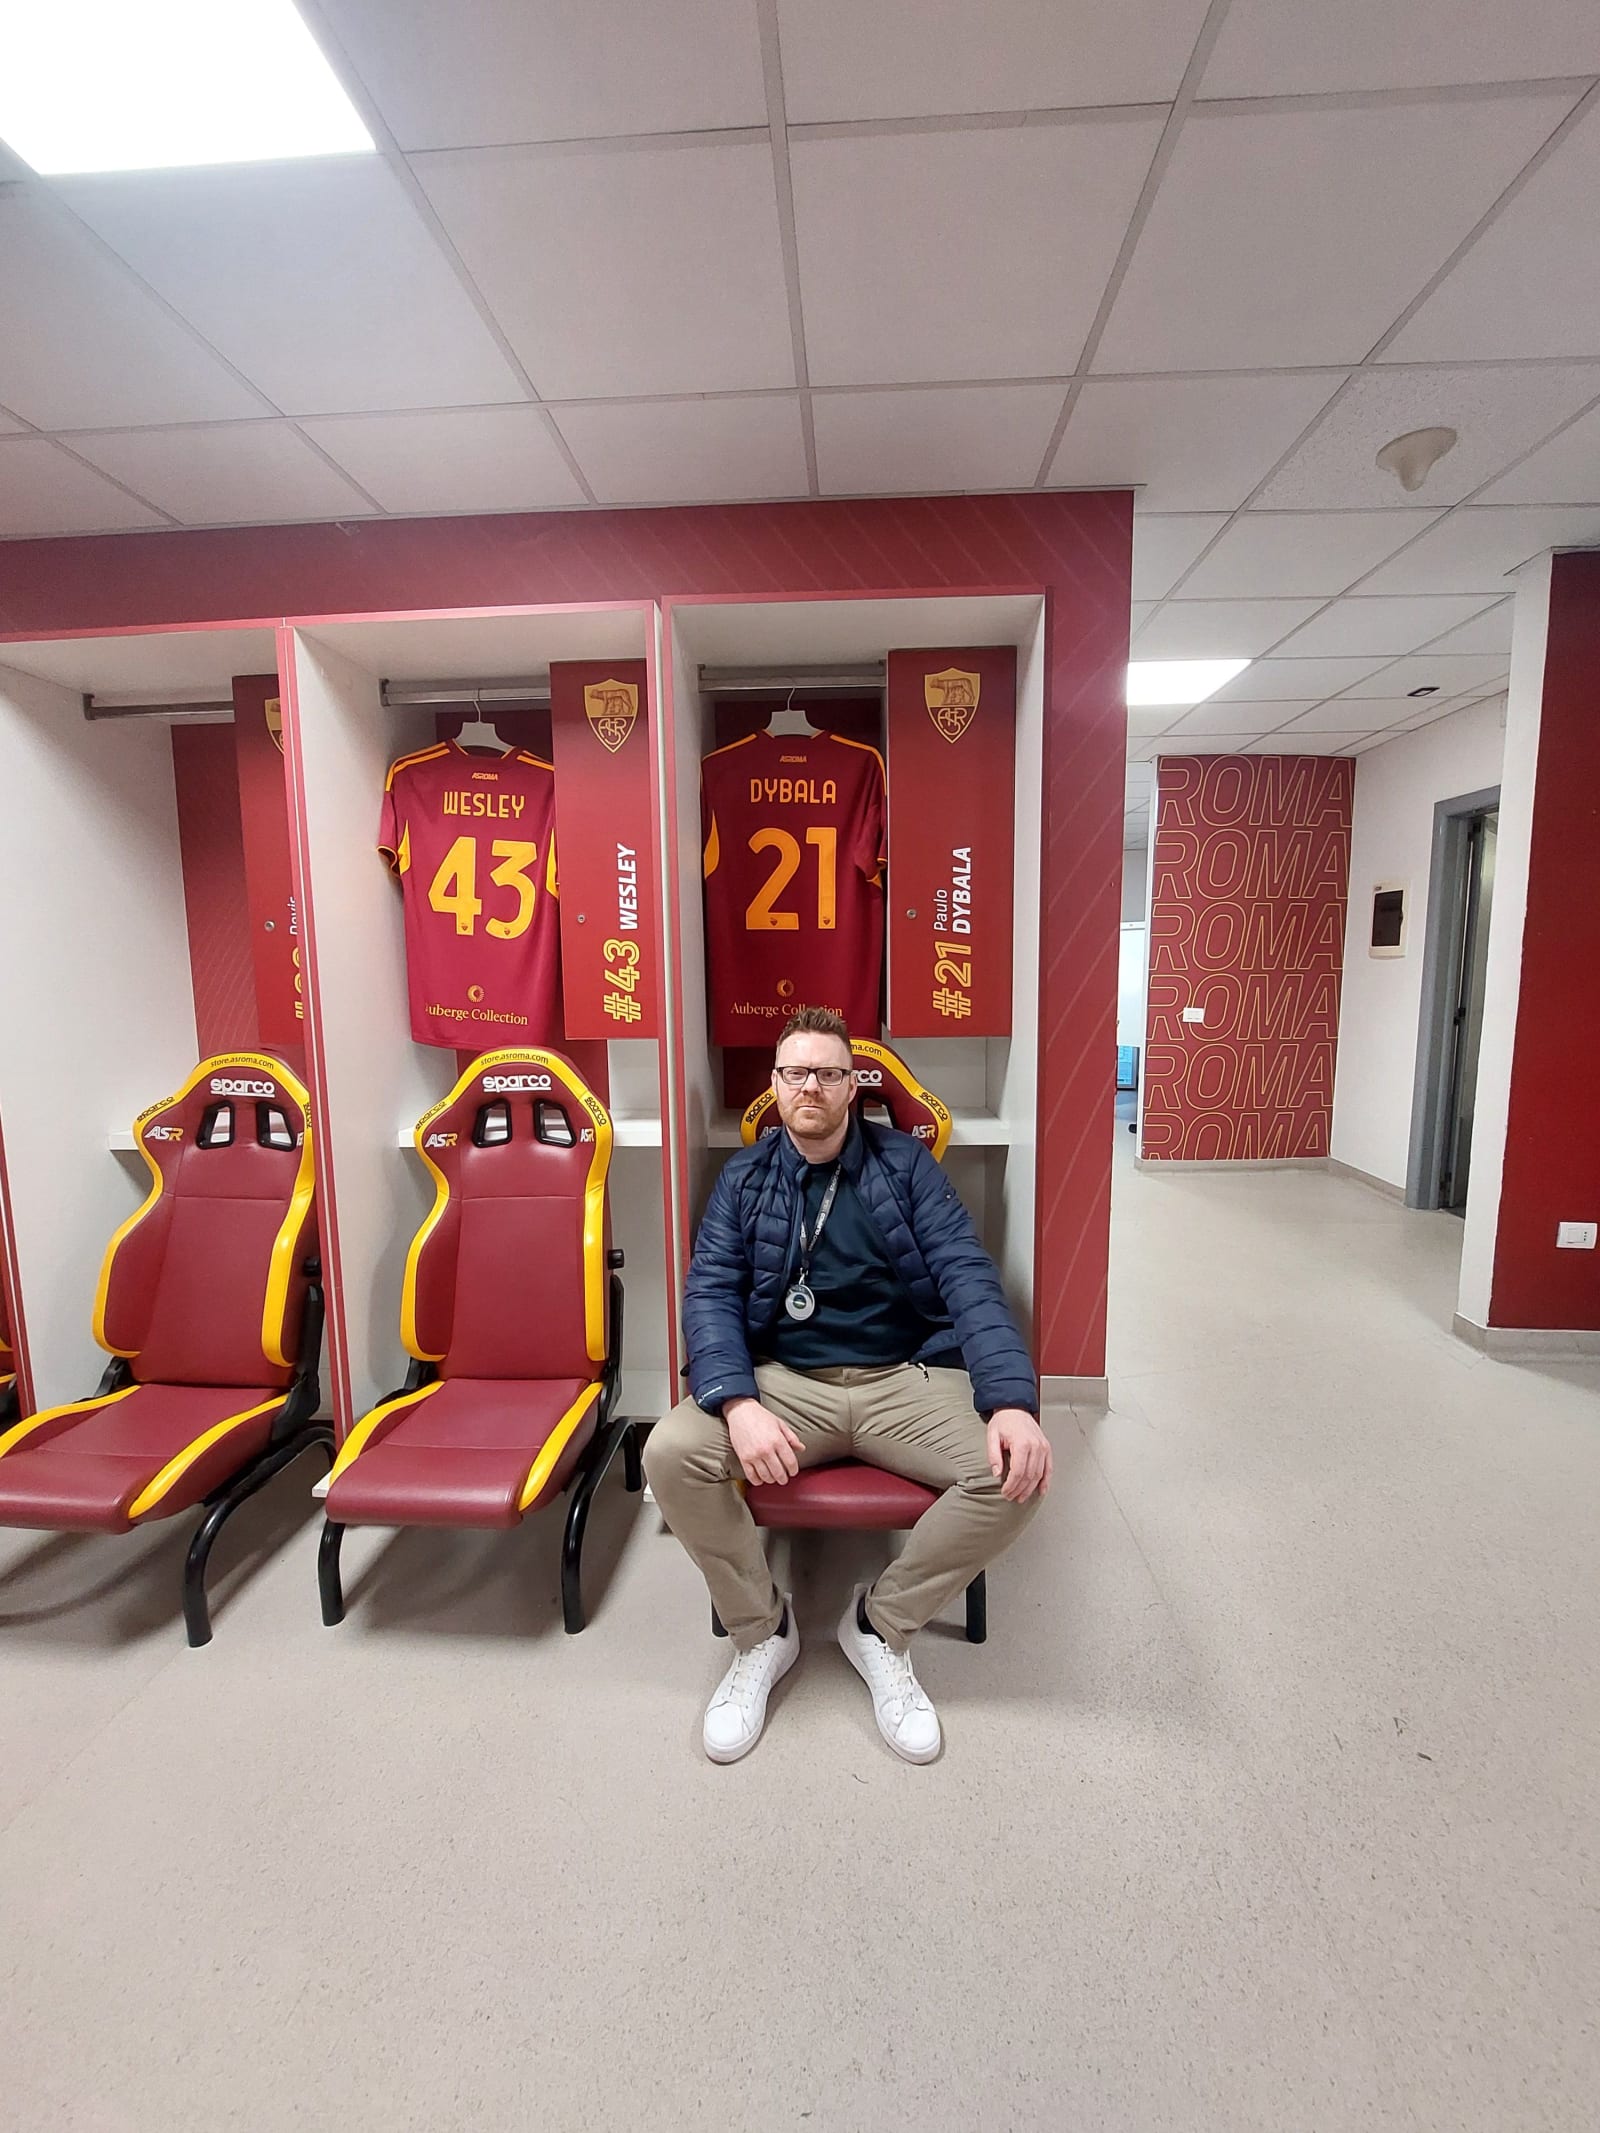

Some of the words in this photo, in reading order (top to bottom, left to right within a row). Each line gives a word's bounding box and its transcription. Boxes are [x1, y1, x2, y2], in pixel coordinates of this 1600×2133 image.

[443, 790, 526, 819] WESLEY
[750, 777, 837, 805] DYBALA
[1156, 754, 1354, 827] ROMA
[745, 826, 838, 931] 21
[1153, 828, 1349, 900] ROMA
[427, 836, 539, 940] 43
[618, 842, 639, 931] WESLEY
[951, 846, 973, 935] DYBALA
[932, 887, 948, 932] Paulo
[1148, 901, 1343, 972] ROMA
[603, 937, 642, 1024] #43
[932, 940, 973, 1020] #21
[425, 1003, 469, 1022] uberge
[471, 1008, 529, 1026] Collection
[730, 1001, 779, 1019] Auberge
[781, 1003, 843, 1018] Collion
[1146, 972, 1339, 1042] ROMA
[210, 1056, 275, 1070] store.asroma.com
[480, 1051, 549, 1066] store.asroma.com
[210, 1078, 276, 1098] sparco
[482, 1074, 552, 1093] sparco
[1143, 1042, 1334, 1111] ROMA
[584, 1096, 607, 1127] sparco
[745, 1092, 775, 1124] sparco
[919, 1091, 948, 1122] sparco
[144, 1125, 185, 1142] ASR
[425, 1132, 458, 1149] ASR
[912, 1124, 936, 1139] ASR
[1142, 1111, 1330, 1160] ROMA
